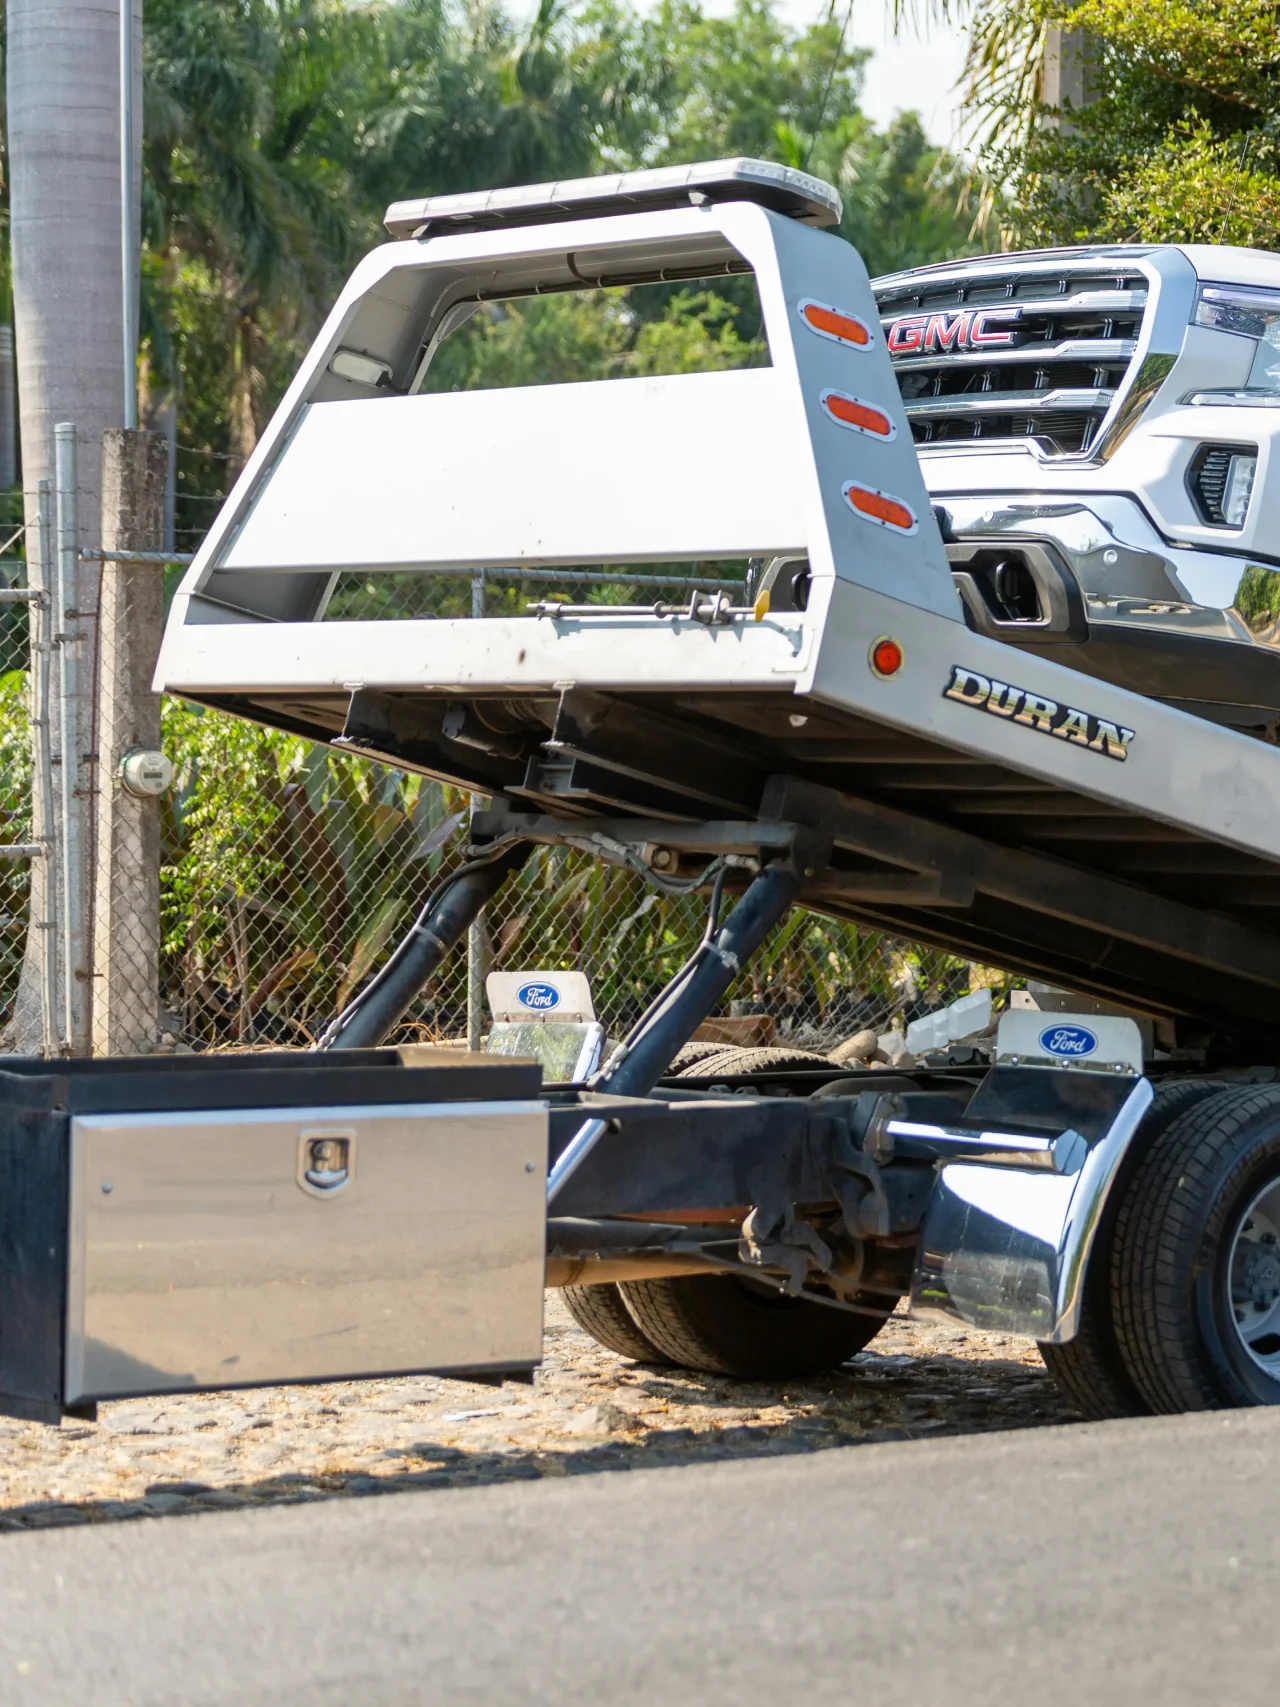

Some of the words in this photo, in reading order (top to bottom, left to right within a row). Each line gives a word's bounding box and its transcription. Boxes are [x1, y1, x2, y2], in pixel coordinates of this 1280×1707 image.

[887, 308, 1021, 354] GMC
[945, 666, 1136, 761] DURAN
[526, 987, 553, 1006] Ford
[1050, 1030, 1087, 1052] Ford
